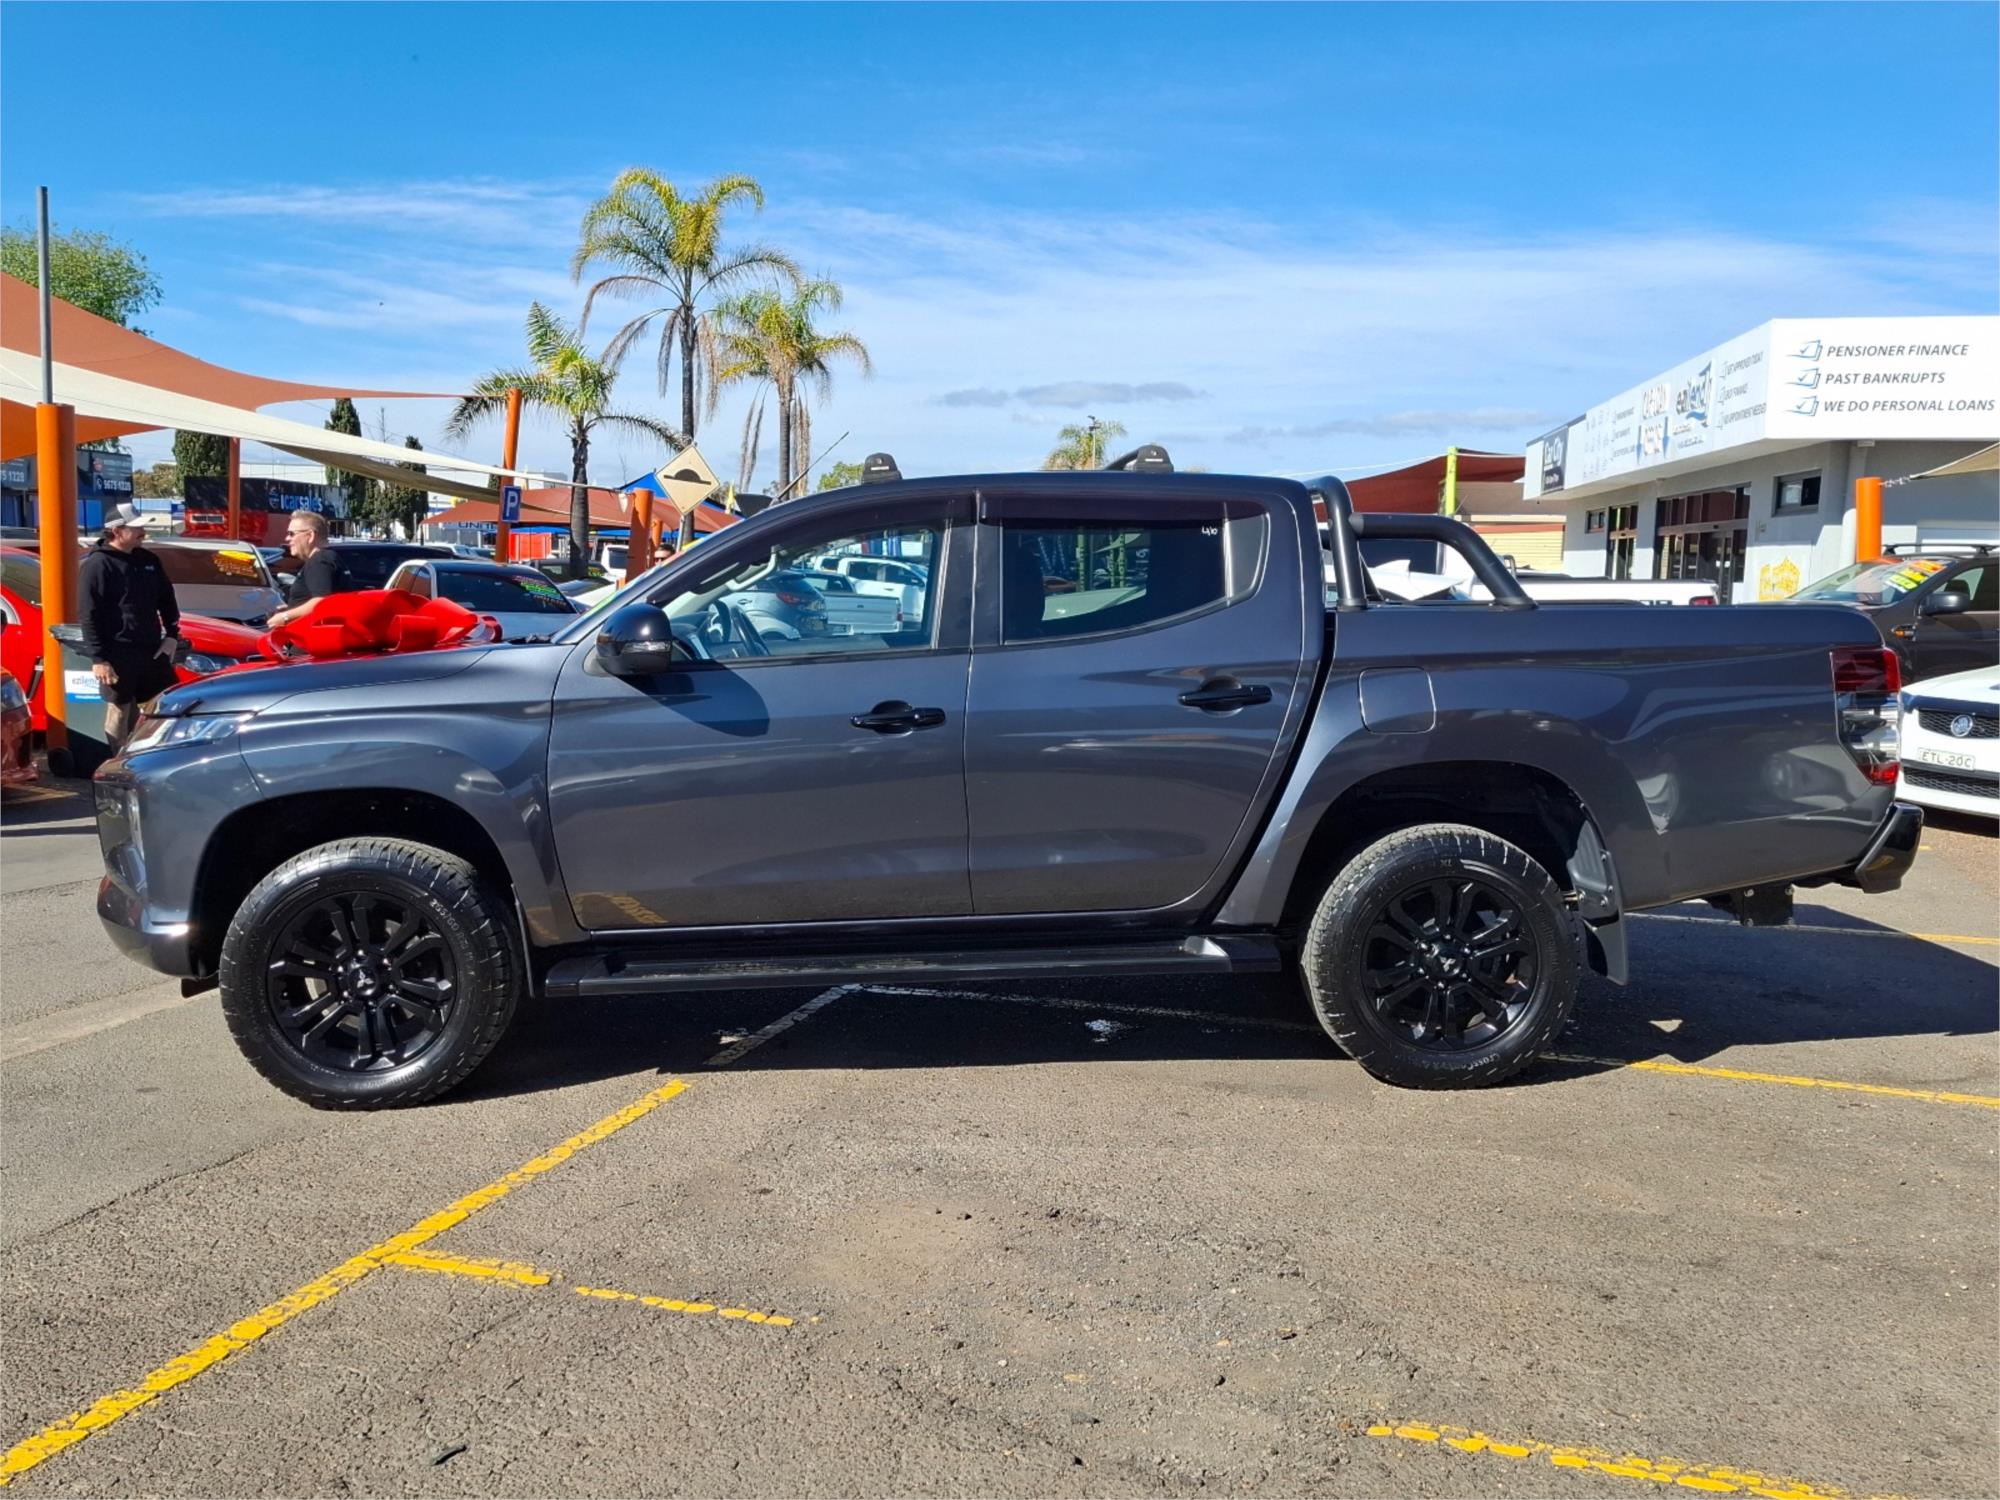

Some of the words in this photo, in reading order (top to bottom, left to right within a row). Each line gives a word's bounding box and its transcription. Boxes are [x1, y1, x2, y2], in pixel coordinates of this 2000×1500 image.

[1827, 344, 1905, 357] PENSIONER
[1908, 344, 1969, 356] FINANCE
[1825, 373, 1860, 385] PAST
[1863, 372, 1946, 384] BANKRUPTS
[1824, 400, 1846, 412] WE
[1848, 400, 1869, 412] DO
[1873, 400, 1944, 411] PERSONAL
[1948, 399, 1996, 411] LOANS
[506, 490, 519, 517] P
